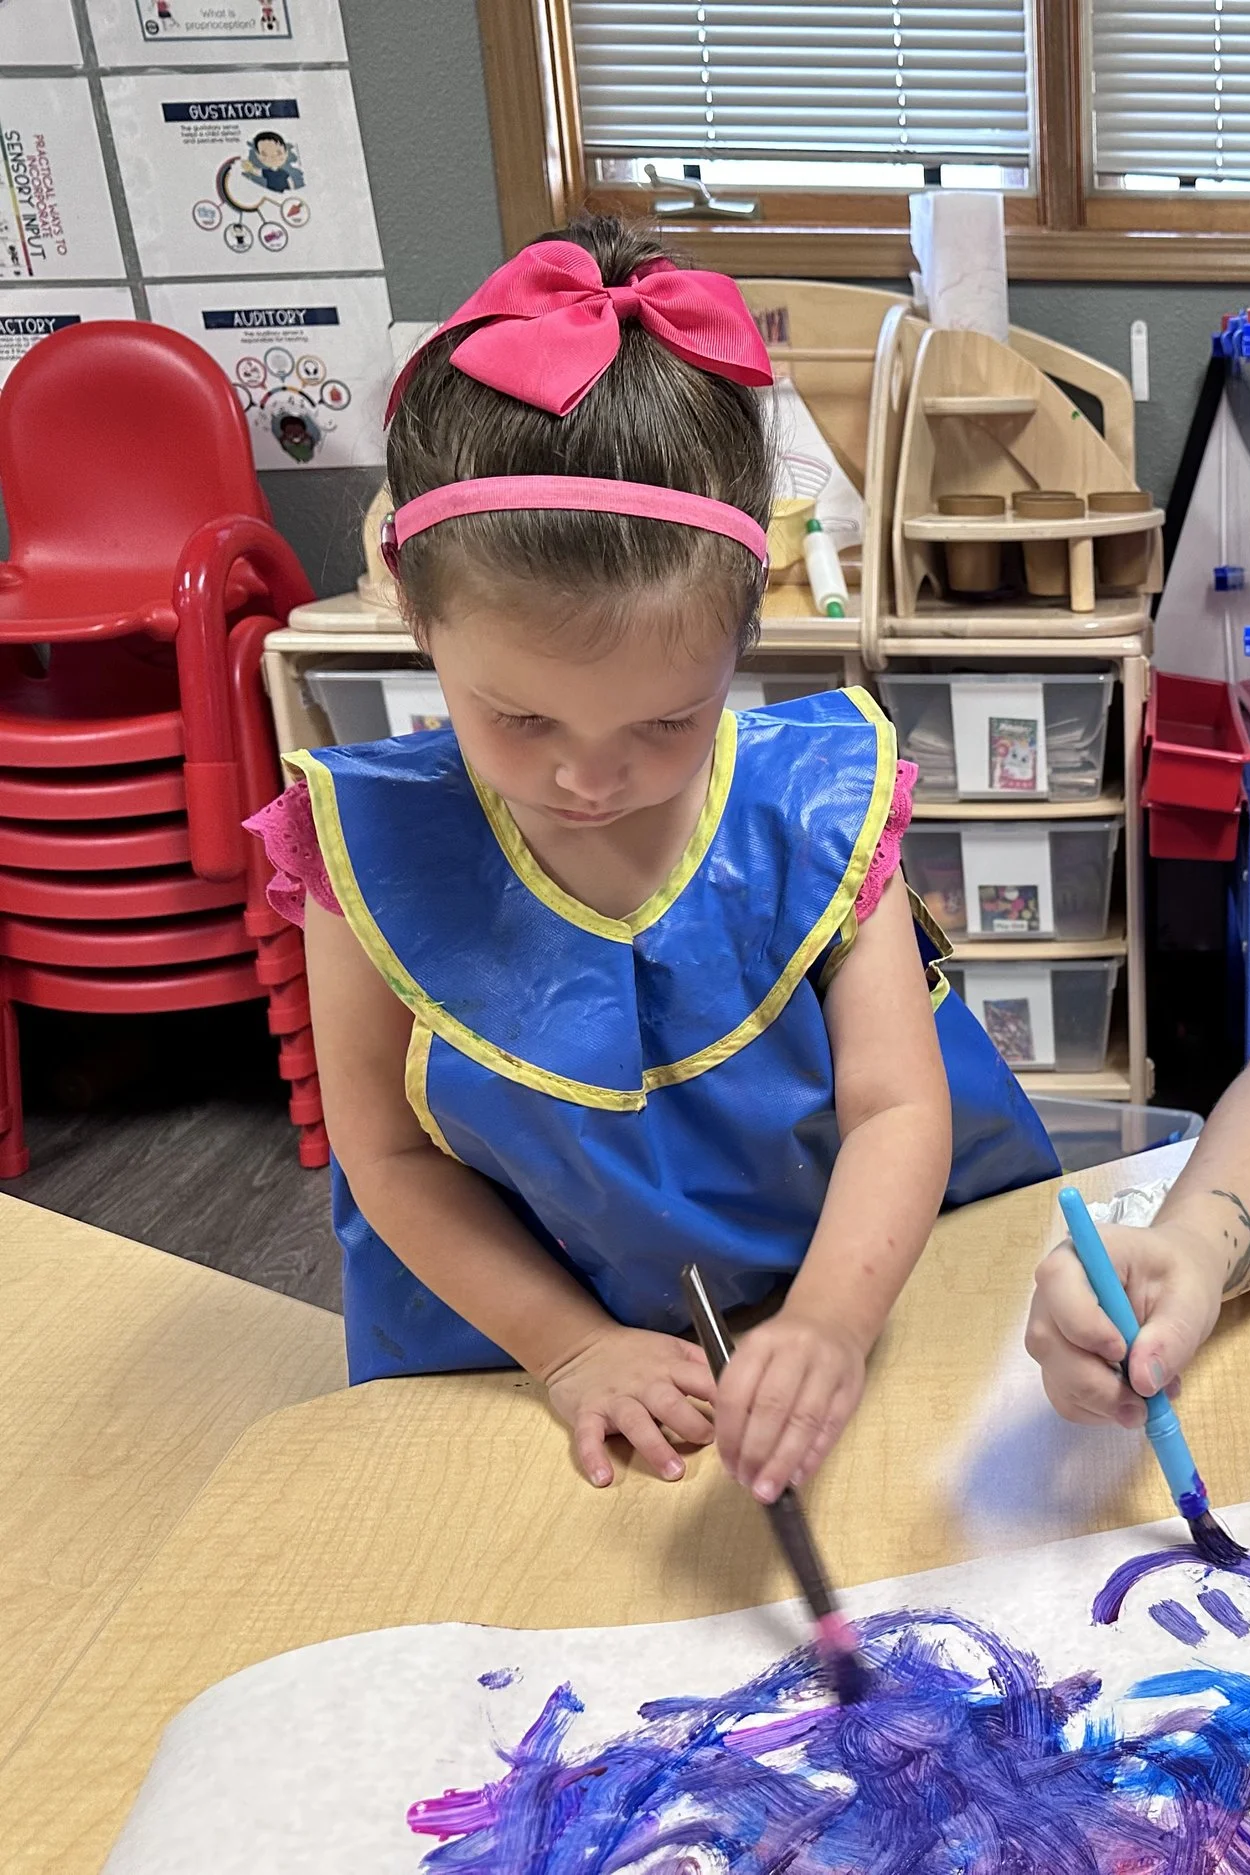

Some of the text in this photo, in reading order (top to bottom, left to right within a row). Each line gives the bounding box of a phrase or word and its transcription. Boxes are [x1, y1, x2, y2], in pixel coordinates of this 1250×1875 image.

[200, 7, 226, 17] What
[184, 18, 256, 31] proprioception?
[188, 102, 273, 120] GUSTATORY
[5, 129, 46, 260] SENSORY INPUT
[26, 154, 53, 239] INCORPORATE
[32, 133, 68, 257] PRACTICAL WAYS TO
[233, 309, 307, 327] AUDITORY
